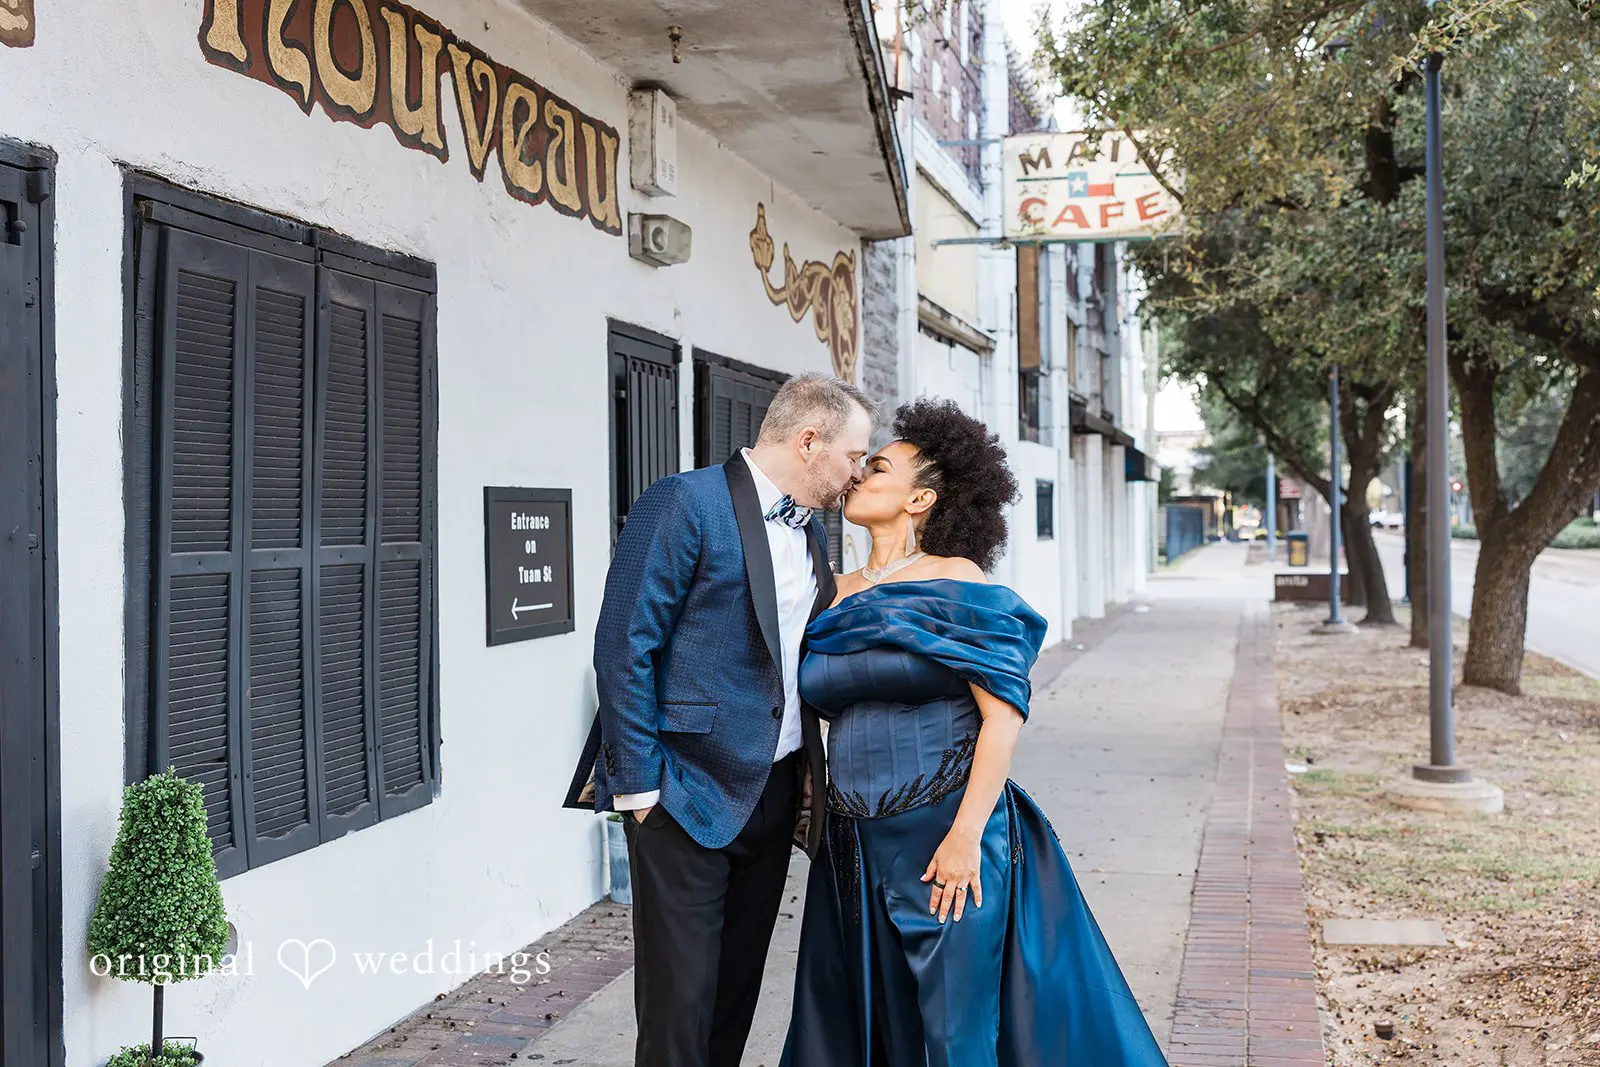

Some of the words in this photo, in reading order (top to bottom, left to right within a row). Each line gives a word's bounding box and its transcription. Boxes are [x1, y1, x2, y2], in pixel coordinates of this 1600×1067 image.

[1019, 191, 1169, 229] CAFE
[511, 512, 550, 530] Entrance
[525, 540, 537, 554] on
[519, 566, 541, 584] Tuam
[543, 565, 552, 582] St
